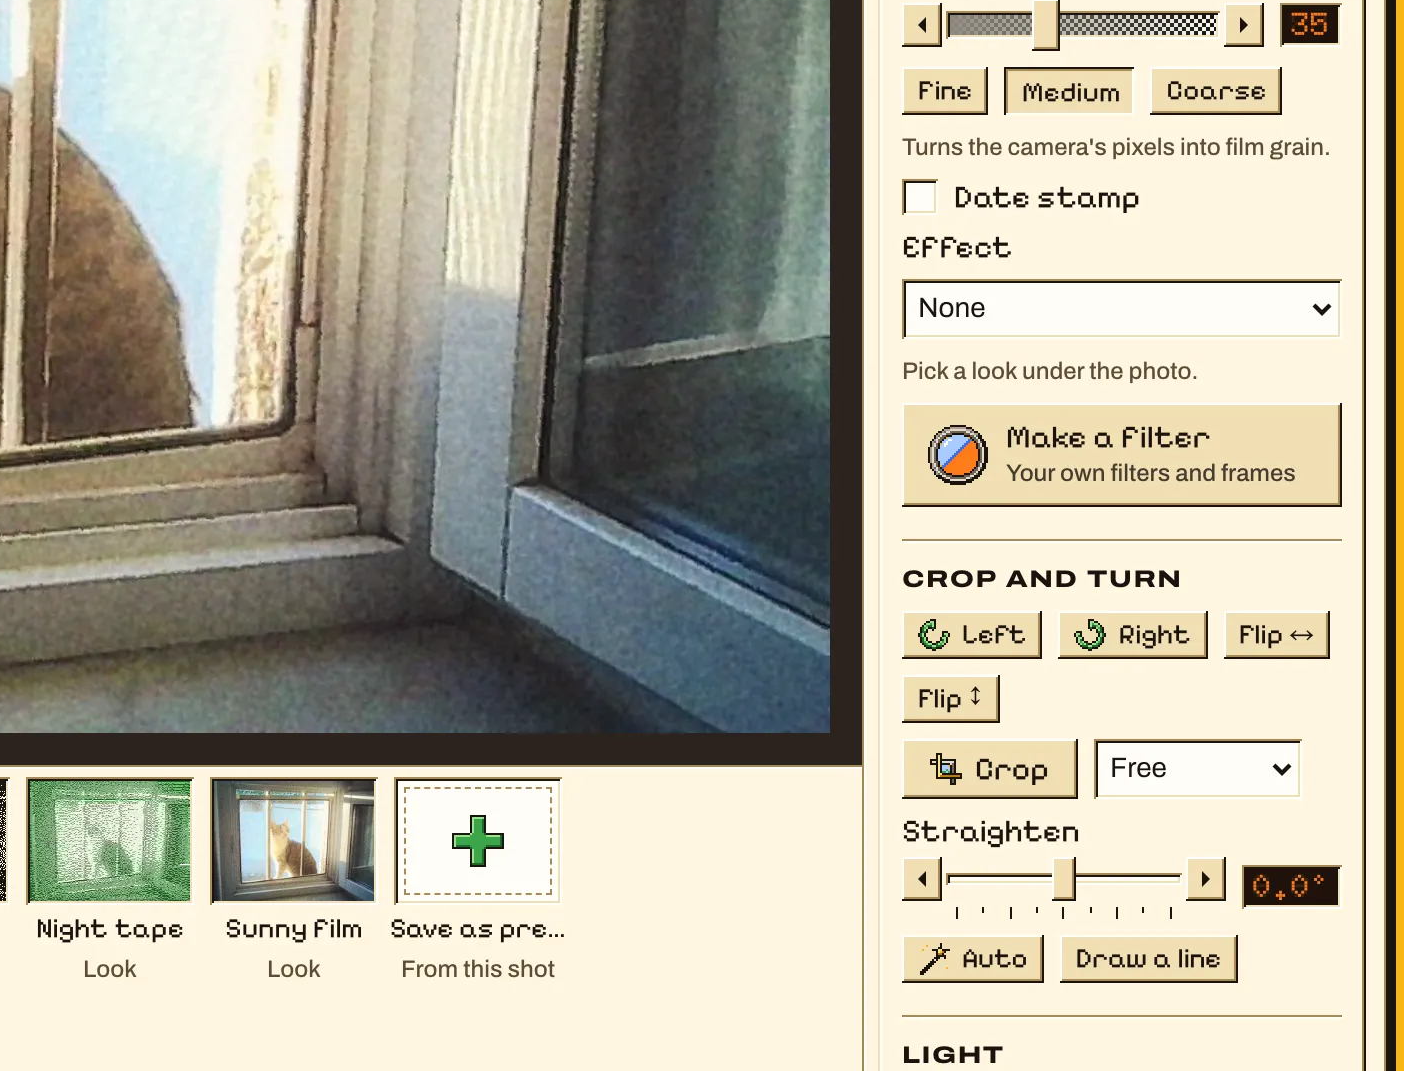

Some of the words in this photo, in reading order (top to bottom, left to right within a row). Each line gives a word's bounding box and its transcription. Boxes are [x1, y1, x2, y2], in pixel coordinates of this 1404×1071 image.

[1291, 12, 1328, 36] 35
[919, 80, 972, 100] Fine
[1023, 82, 1120, 102] Medium
[1167, 80, 1266, 100] Coarse
[901, 137, 963, 156] Turns
[967, 137, 1003, 156] the
[1007, 137, 1107, 156] camera's
[1112, 137, 1175, 160] pixels
[1180, 137, 1221, 156] into
[1225, 136, 1264, 156] film
[1269, 137, 1330, 161] grain.
[955, 186, 1029, 209] Date
[1038, 186, 1139, 214] stamp
[903, 236, 1012, 259] Effect
[919, 297, 986, 318] None
[903, 360, 950, 380] Pick
[953, 365, 967, 380] a
[972, 360, 1018, 380] look
[1022, 361, 1086, 380] under
[1088, 360, 1124, 380] the
[1129, 361, 1197, 384] photo.
[1007, 426, 1086, 449] Make
[1094, 431, 1114, 449] a
[1122, 426, 1210, 449] Filter
[902, 569, 997, 588] CROP
[1005, 569, 1077, 588] AND
[1086, 569, 1180, 588] TURN
[963, 624, 1026, 644] Left
[1119, 624, 1190, 650] Right
[1240, 624, 1283, 649] Flip
[976, 758, 1048, 786] Crop
[1111, 757, 1167, 778] Free
[903, 820, 1079, 848] Straighten
[37, 918, 108, 944] Night
[115, 918, 183, 943] tape
[226, 918, 307, 944] Sunny
[314, 918, 362, 938] film
[391, 918, 453, 938] Save
[460, 923, 493, 938] as
[500, 923, 565, 943] pre...
[963, 948, 1027, 968] Auto
[1076, 948, 1147, 968] Draw
[1153, 953, 1171, 968] a
[1178, 948, 1221, 969] line
[903, 1045, 1004, 1064] LIGHT
